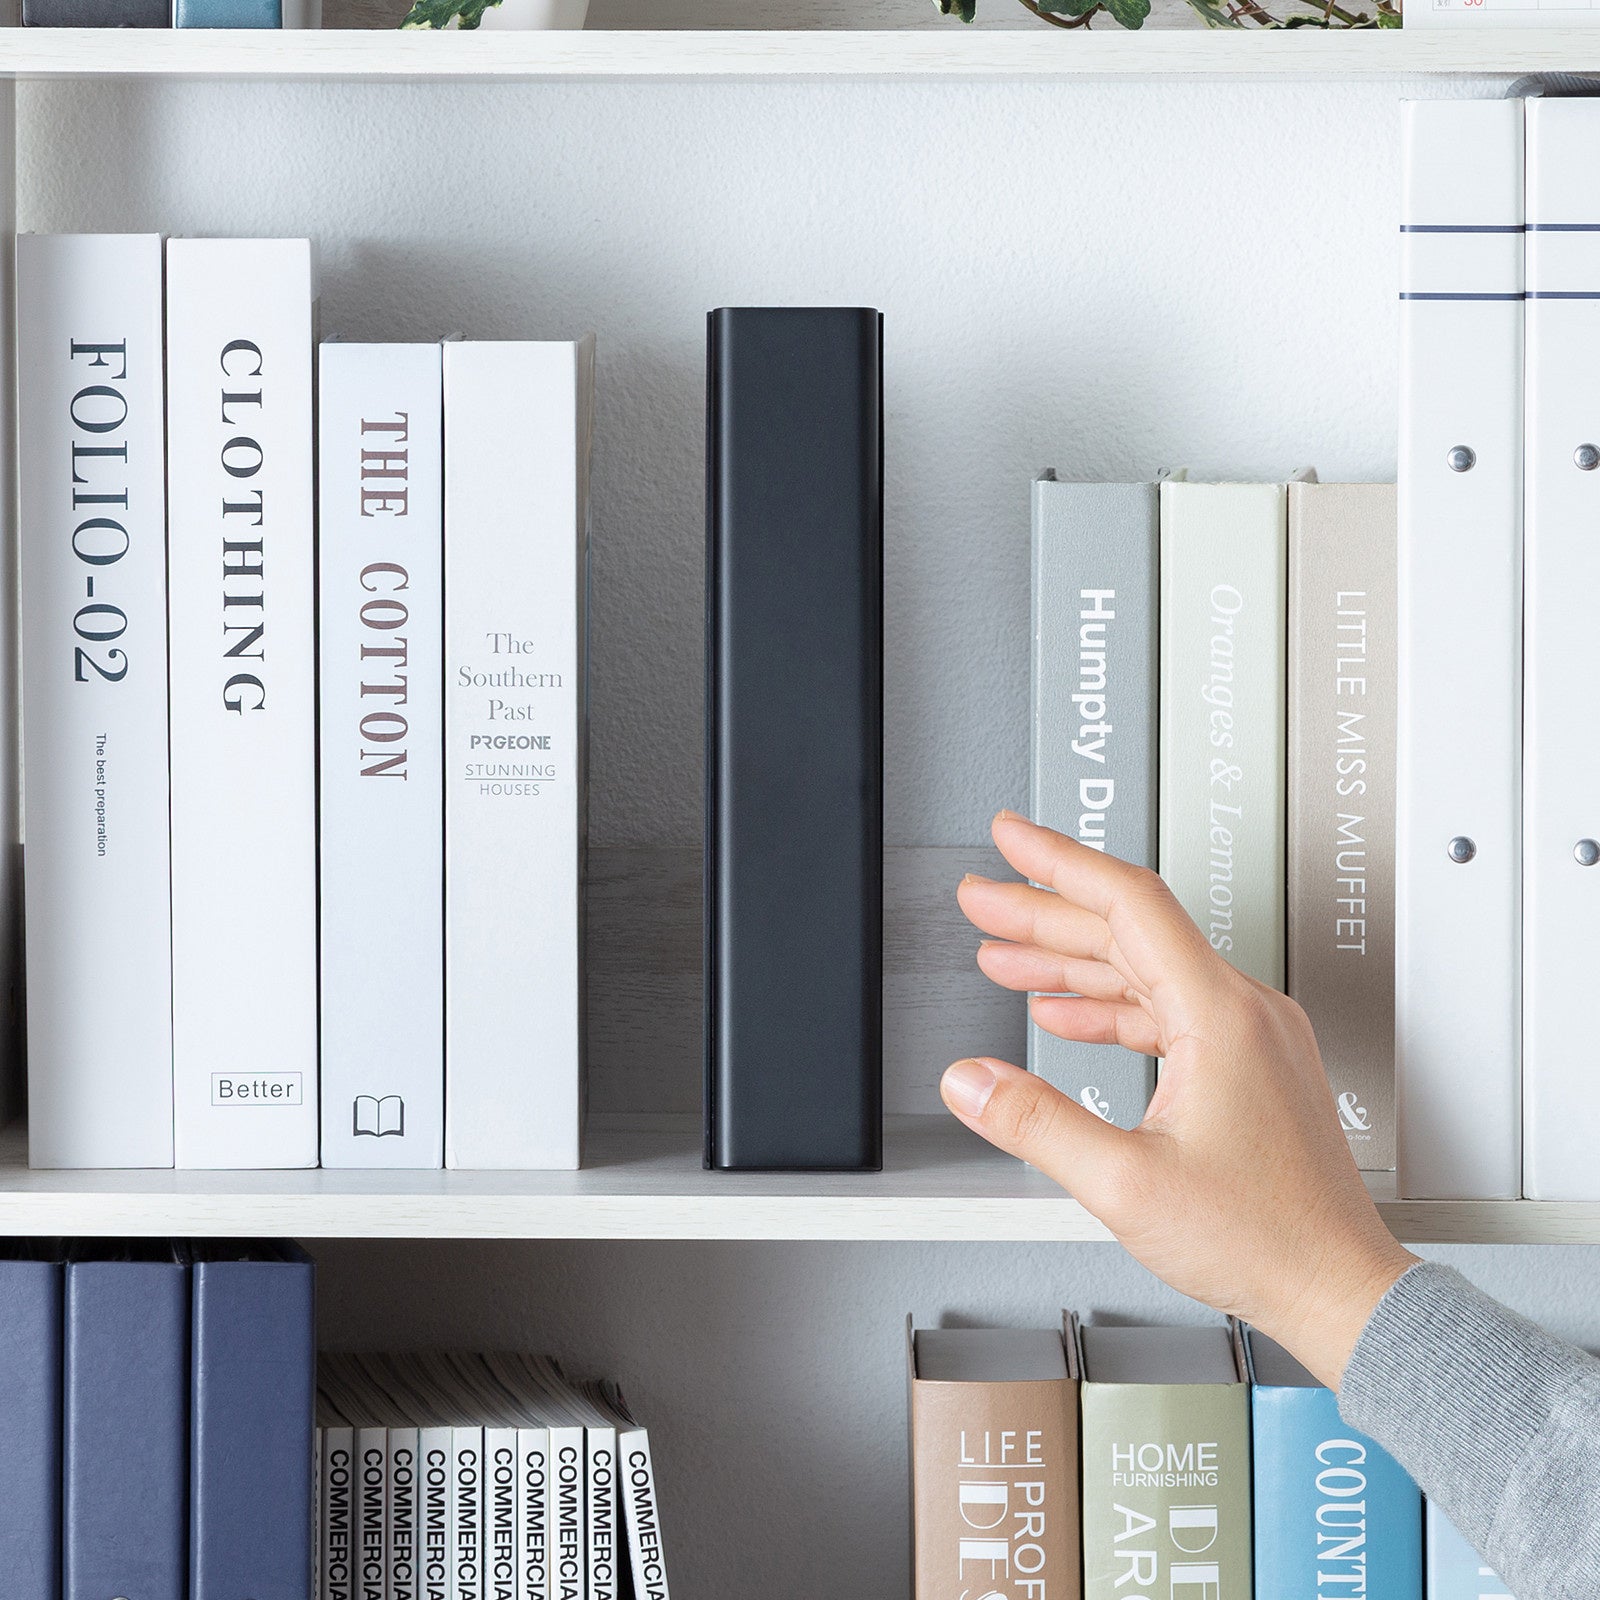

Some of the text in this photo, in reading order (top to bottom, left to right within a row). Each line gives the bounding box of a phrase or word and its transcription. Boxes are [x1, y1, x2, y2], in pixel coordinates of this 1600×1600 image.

[69, 337, 130, 684] FOLIO-02
[220, 339, 266, 716] CLOTHING
[359, 411, 410, 782] THE COTTON
[486, 632, 535, 655] The
[458, 665, 563, 688] Southern
[487, 699, 535, 721] Past
[1071, 589, 1116, 852] Humpty Du
[95, 733, 108, 857] The best preparation
[465, 764, 556, 777] STUNNING
[480, 783, 540, 796] HOUSES
[1201, 583, 1243, 952] Oranges & Lemons
[1336, 591, 1367, 955] LITTLE MISS MUFFET
[219, 1079, 295, 1098] Better
[960, 1430, 1042, 1464] LIFE
[1112, 1442, 1219, 1472] HOME
[1112, 1472, 1219, 1487] FURNISHING
[1113, 1503, 1158, 1600] AR
[1315, 1439, 1367, 1600] COUNT
